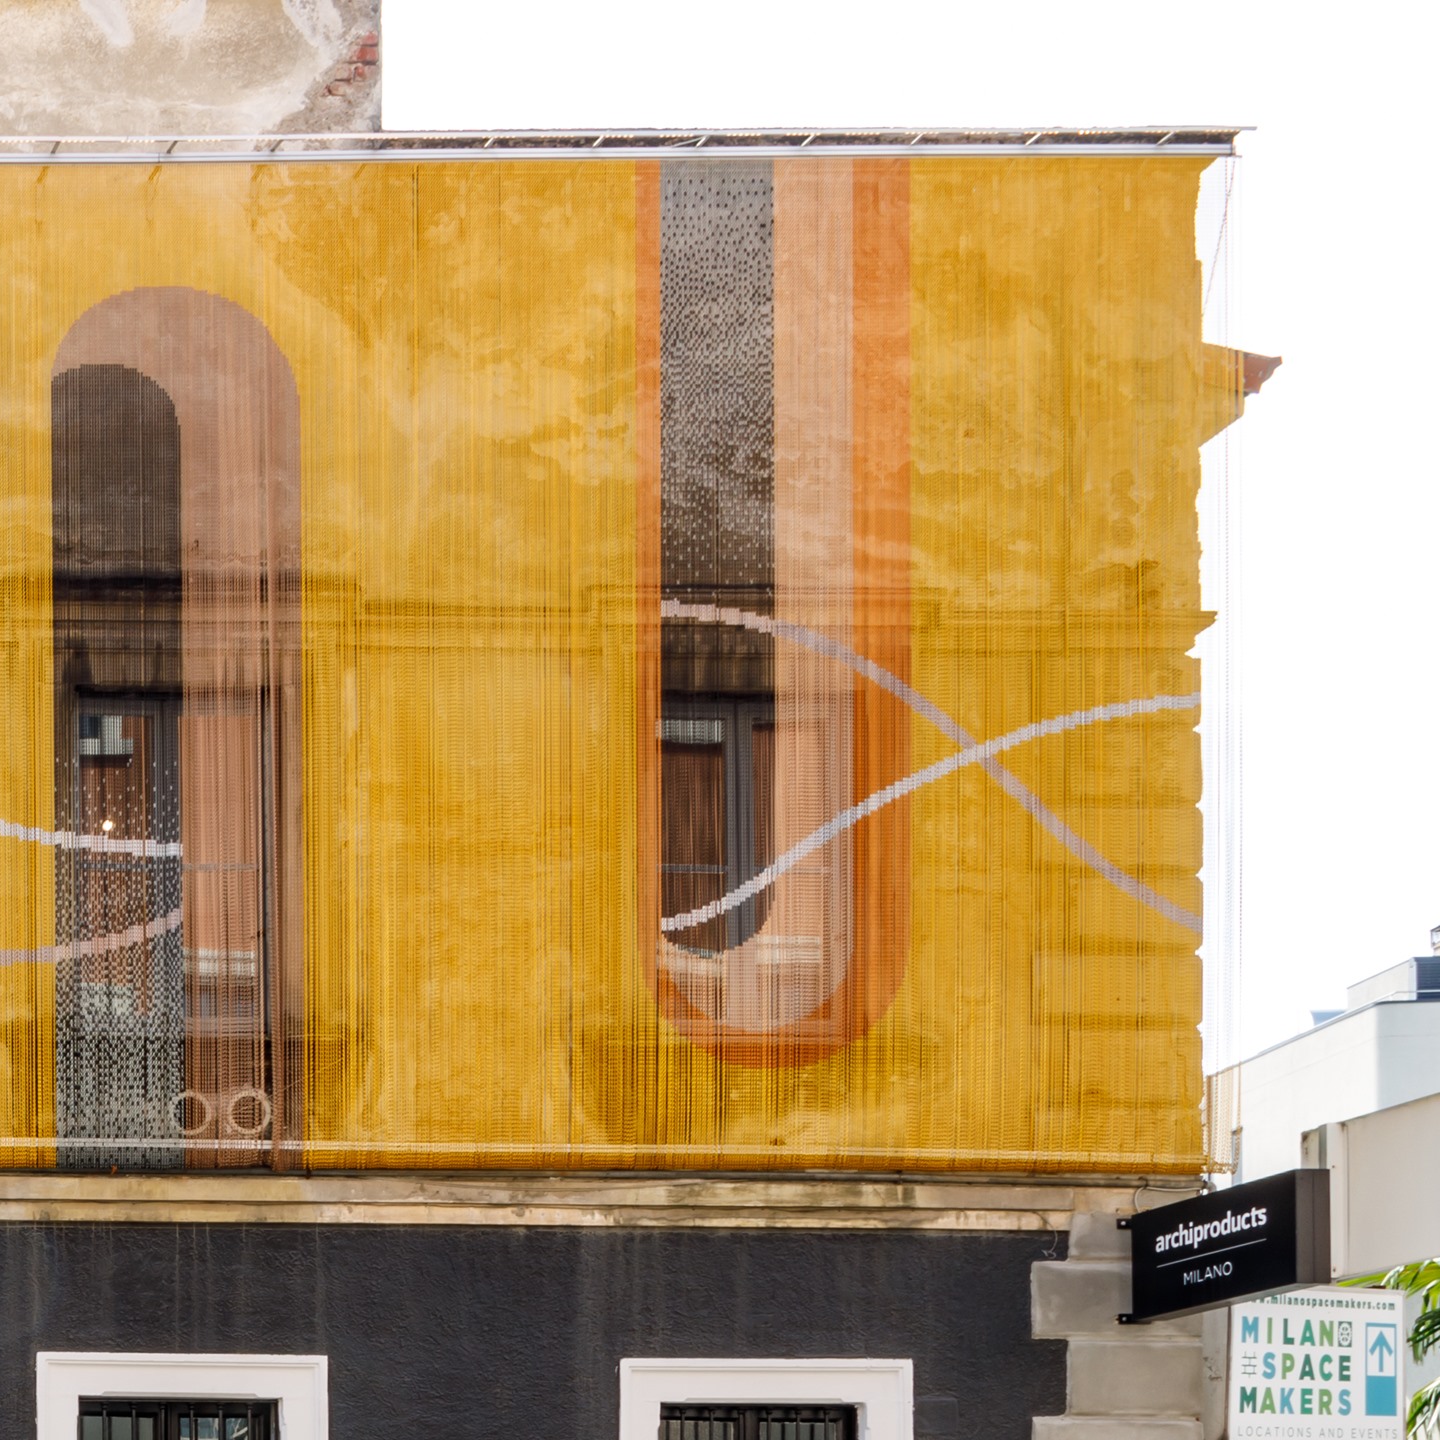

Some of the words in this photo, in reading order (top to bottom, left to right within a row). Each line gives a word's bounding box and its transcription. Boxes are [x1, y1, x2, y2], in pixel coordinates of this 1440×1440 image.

[1155, 1207, 1267, 1253] archiproducts
[1183, 1261, 1233, 1286] MILANO
[1239, 1386, 1352, 1416] MAKERS
[1237, 1426, 1312, 1438] LOCATIONS
[1320, 1428, 1344, 1439] AND
[1351, 1428, 1398, 1439] EVENTS
